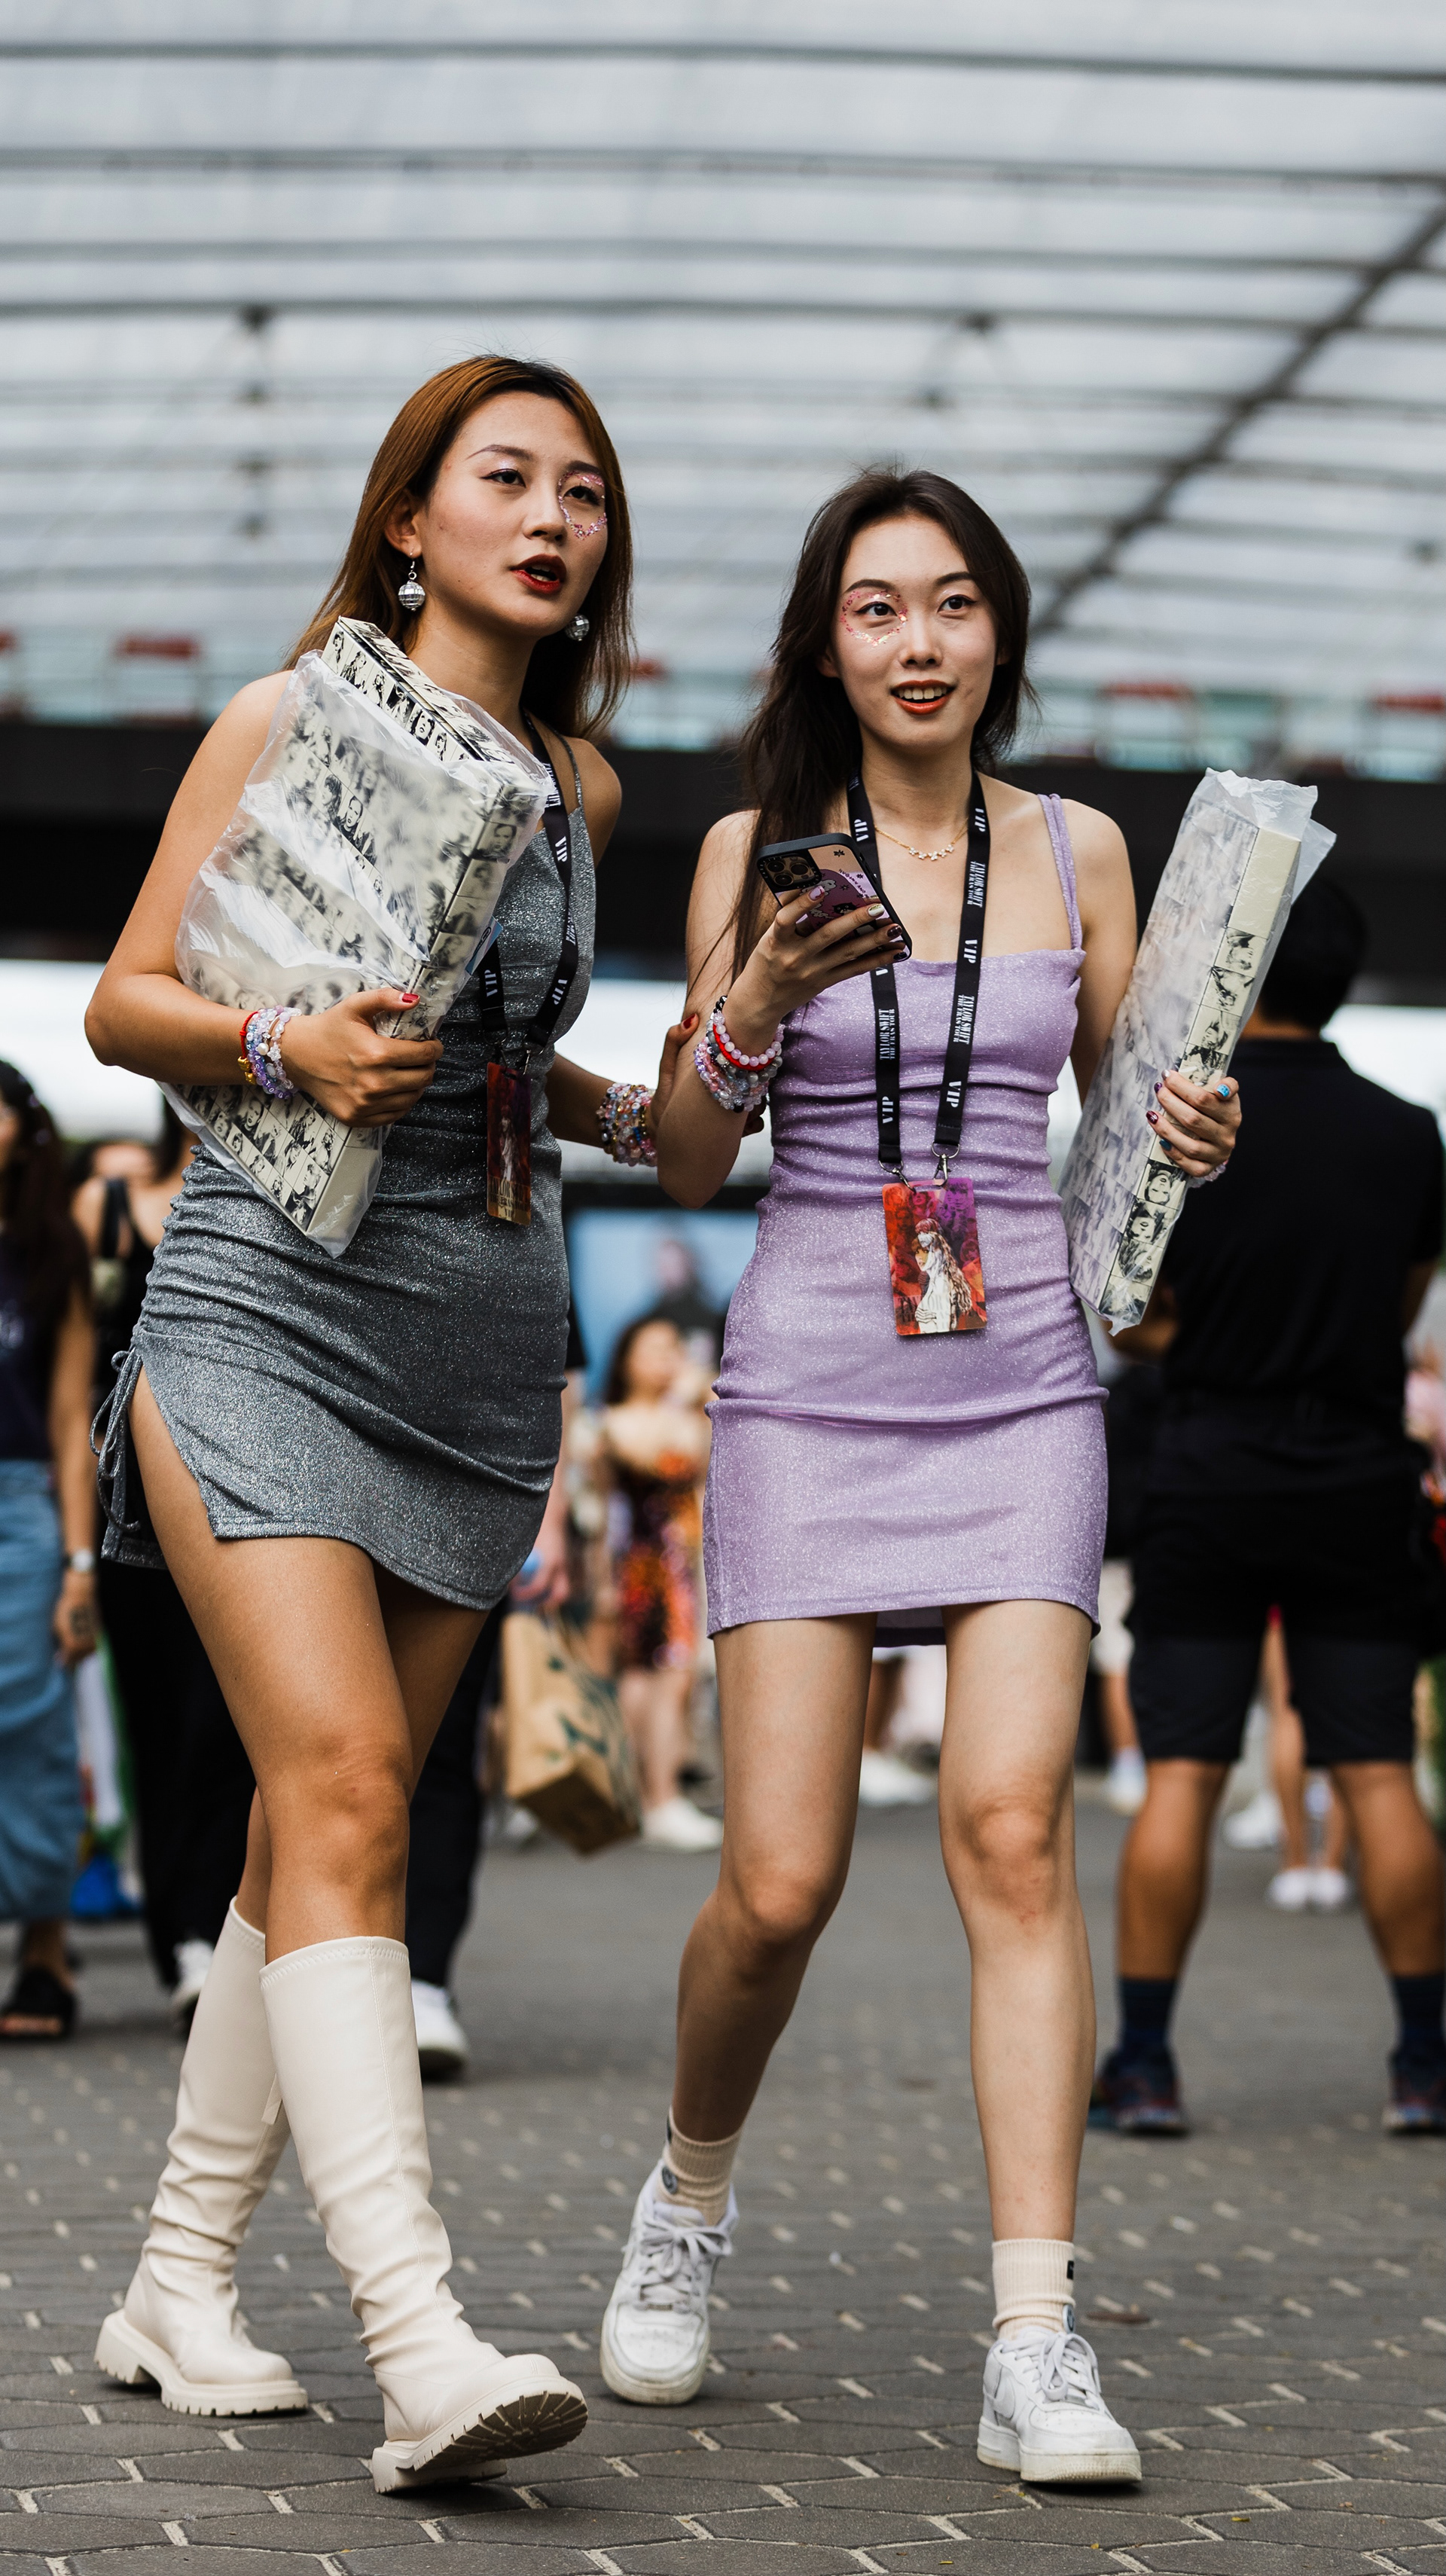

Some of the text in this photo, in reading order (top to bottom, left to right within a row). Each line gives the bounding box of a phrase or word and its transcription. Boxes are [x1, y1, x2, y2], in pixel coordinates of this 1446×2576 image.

[854, 819, 869, 841] VIP
[975, 808, 986, 832] VIP
[555, 836, 567, 862] VIP
[972, 862, 986, 908] TAYLOR SWIFT
[963, 939, 978, 963] VIP
[484, 969, 498, 997] VIP
[551, 979, 568, 1005] VIP
[959, 996, 975, 1045] TAYLOR SWIFT
[878, 1009, 890, 1060] TAYLOR SWIFT
[946, 1081, 962, 1108] VIP
[882, 1096, 893, 1124] VIP
